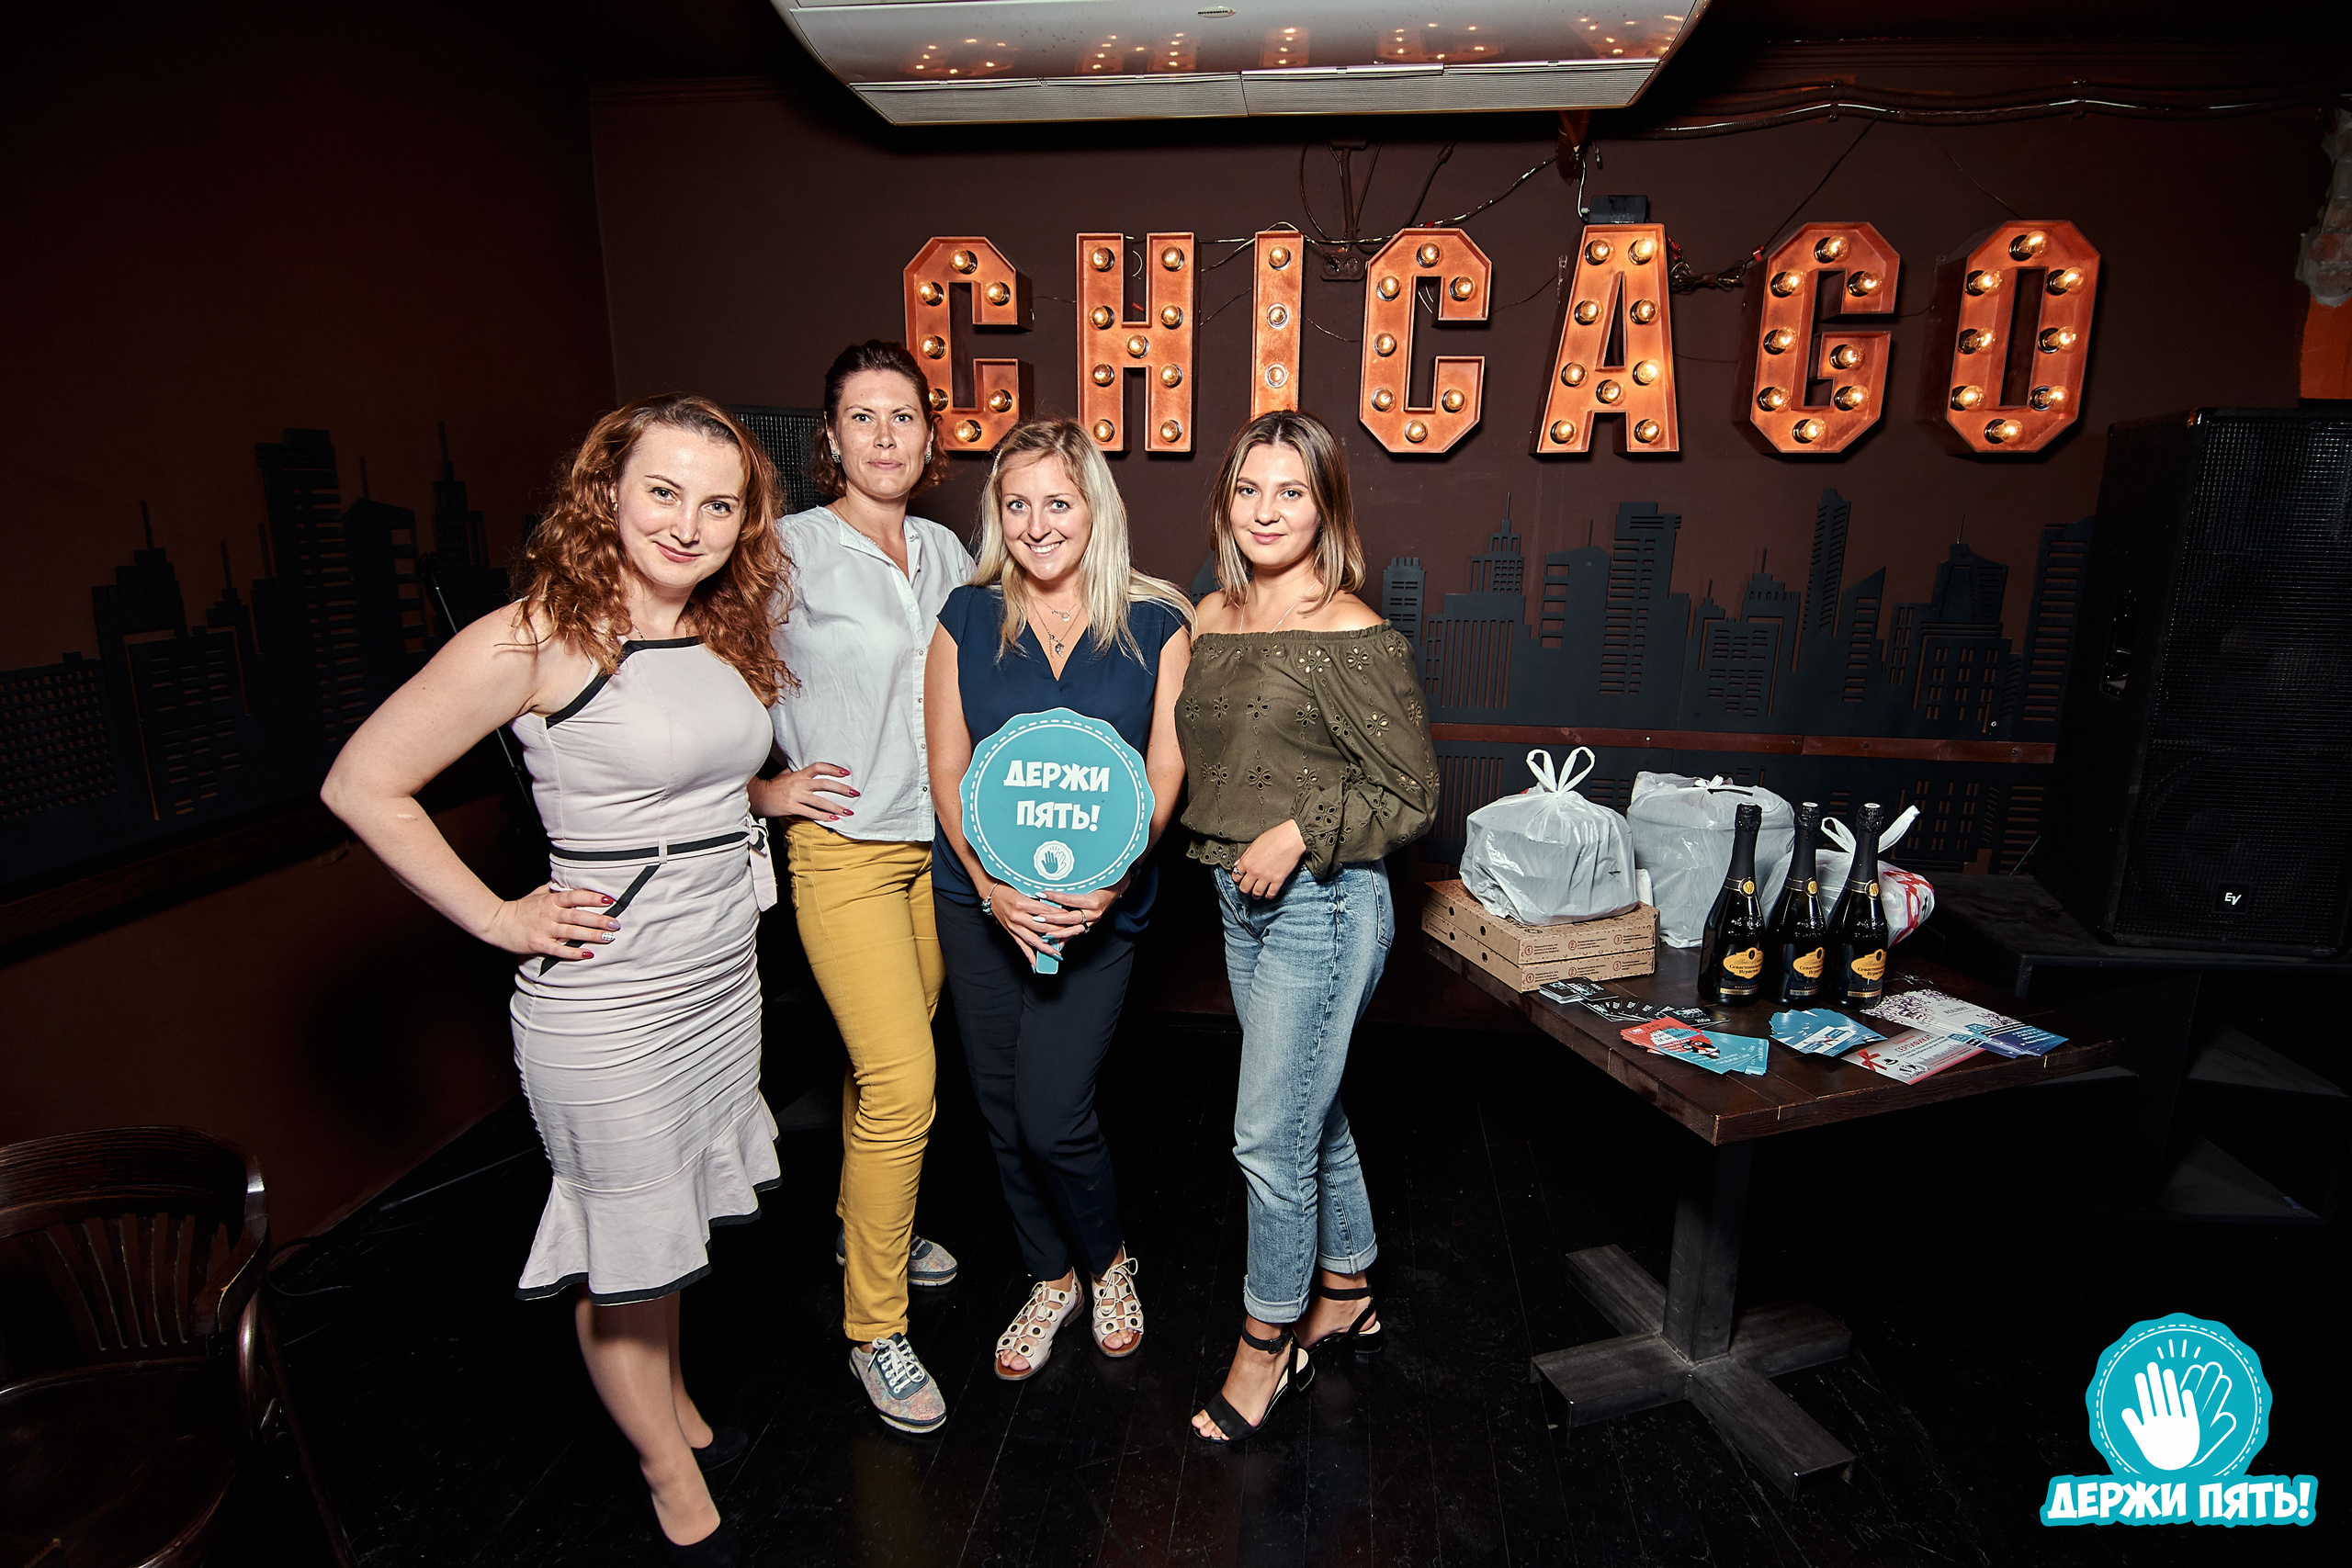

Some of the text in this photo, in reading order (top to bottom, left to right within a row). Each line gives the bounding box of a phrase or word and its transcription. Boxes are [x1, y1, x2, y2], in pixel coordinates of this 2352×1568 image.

[903, 220, 2101, 456] CHICAGO
[1003, 760, 1110, 793] ДЕРЖИ
[1016, 800, 1101, 832] ПЯТЬ!
[2224, 892, 2242, 906] EV
